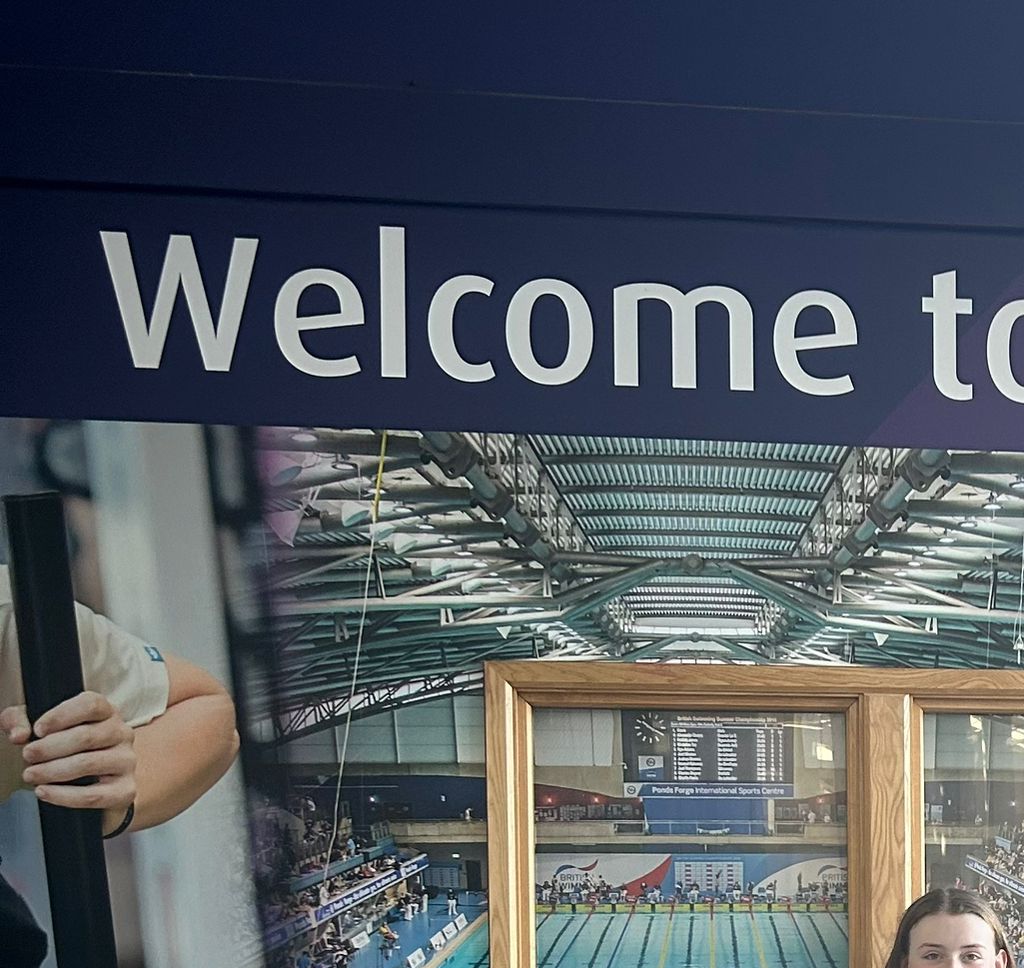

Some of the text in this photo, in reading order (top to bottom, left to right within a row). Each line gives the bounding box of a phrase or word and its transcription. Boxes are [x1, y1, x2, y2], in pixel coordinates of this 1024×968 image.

[98, 224, 859, 397] Welcome
[651, 785, 785, 796] Ponds Forge International Sports Centre
